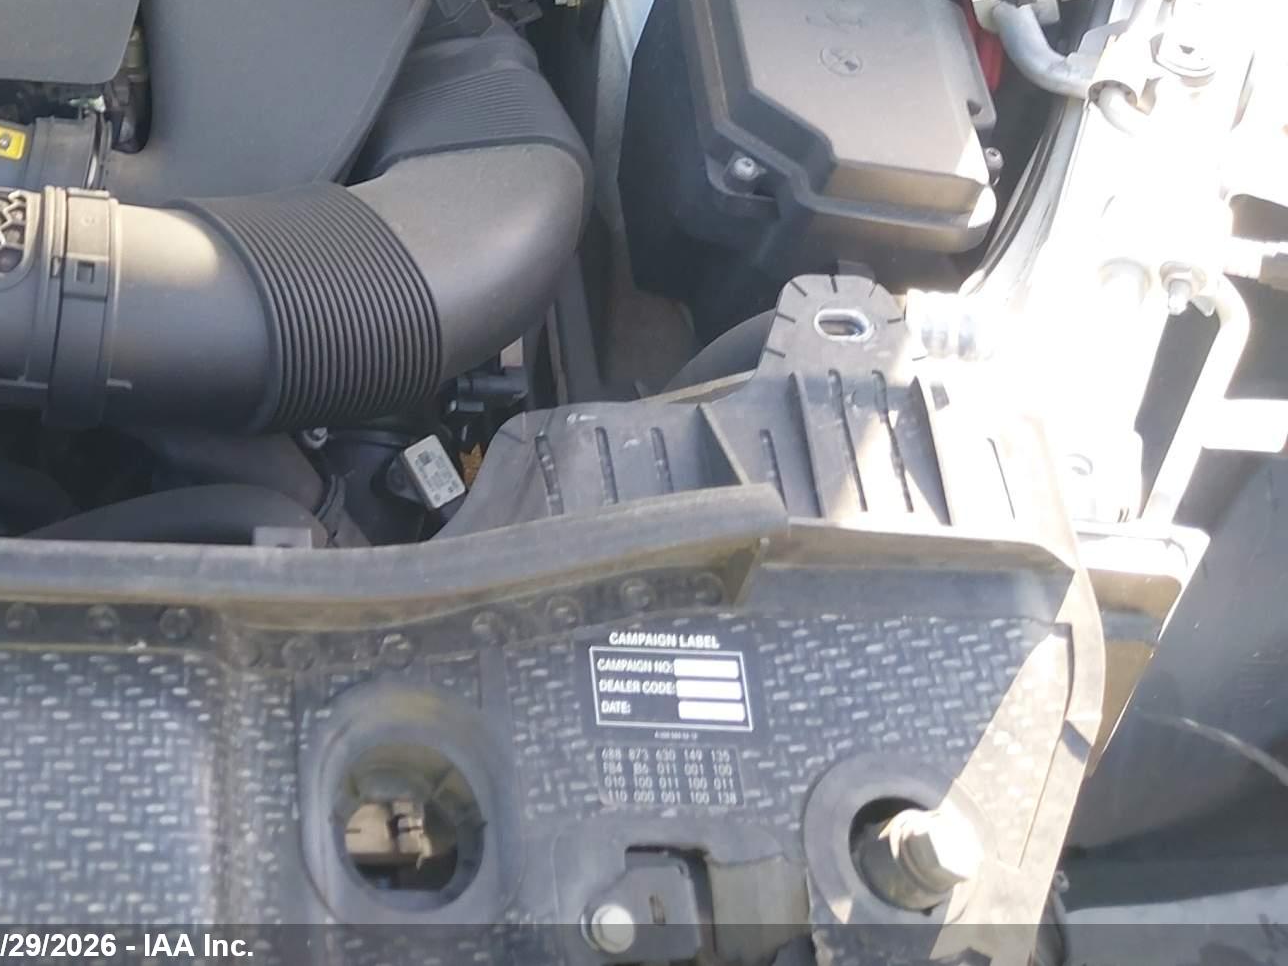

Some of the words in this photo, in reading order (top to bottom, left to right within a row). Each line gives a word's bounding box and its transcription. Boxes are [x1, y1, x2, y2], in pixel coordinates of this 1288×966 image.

[609, 632, 677, 647] CAMPAIGN
[679, 634, 720, 649] LABEL
[597, 658, 652, 673] CAMPAIGN
[599, 679, 640, 693] DEALER
[642, 680, 676, 695] CODE:
[601, 700, 631, 714] DATE:
[656, 762, 677, 775] 011
